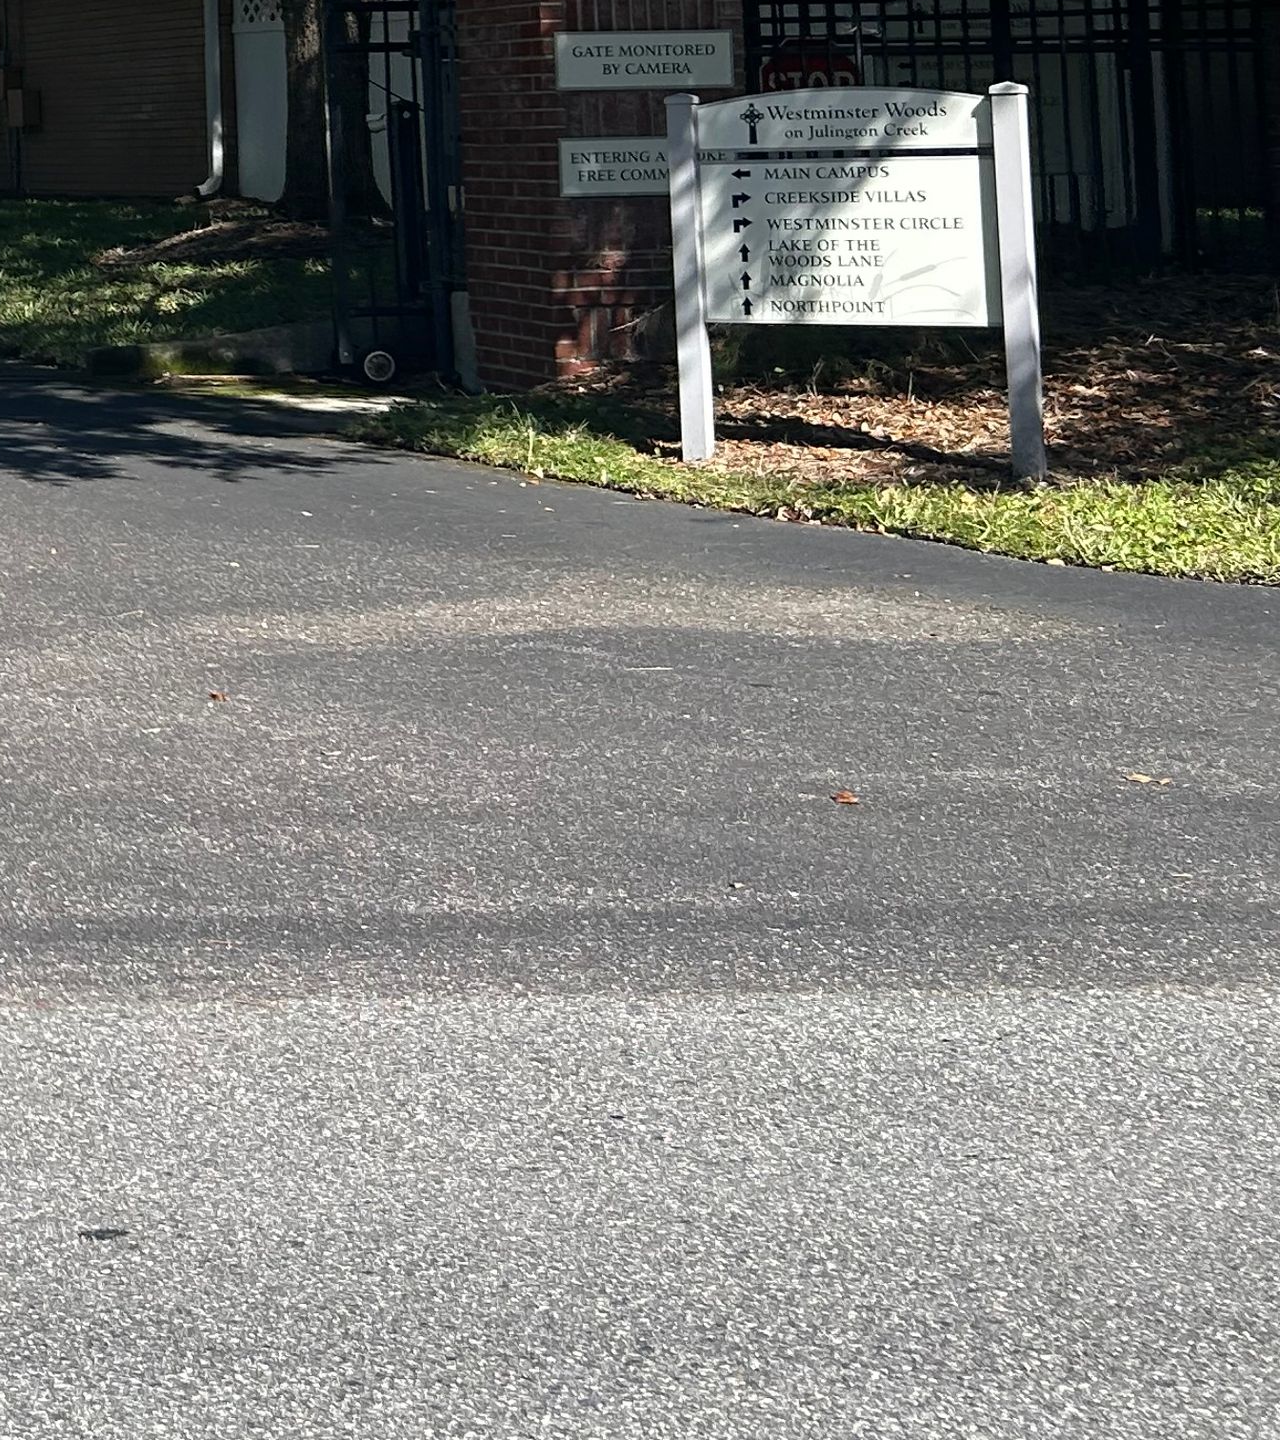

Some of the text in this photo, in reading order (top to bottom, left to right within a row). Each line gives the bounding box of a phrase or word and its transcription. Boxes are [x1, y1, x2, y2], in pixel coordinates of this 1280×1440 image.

[572, 44, 716, 58] GATE MONITORED
[602, 62, 693, 76] BY CAMERA
[766, 100, 947, 121] Westminster Woods
[784, 122, 929, 141] on Julington Creek
[570, 151, 654, 165] ENTERING
[656, 151, 667, 162] A
[578, 168, 670, 182] FREE COMM
[764, 165, 890, 180] MAIN CAMPUS
[764, 189, 927, 204] CREEKSIDE VILLAS
[766, 216, 965, 231] WESTMINSTER CIRCLE
[768, 239, 881, 252] LAKE OF THE
[768, 255, 885, 268] WOODS LANE
[770, 273, 865, 287] MAGNOLIA
[770, 300, 886, 313] NORTHPOINT
